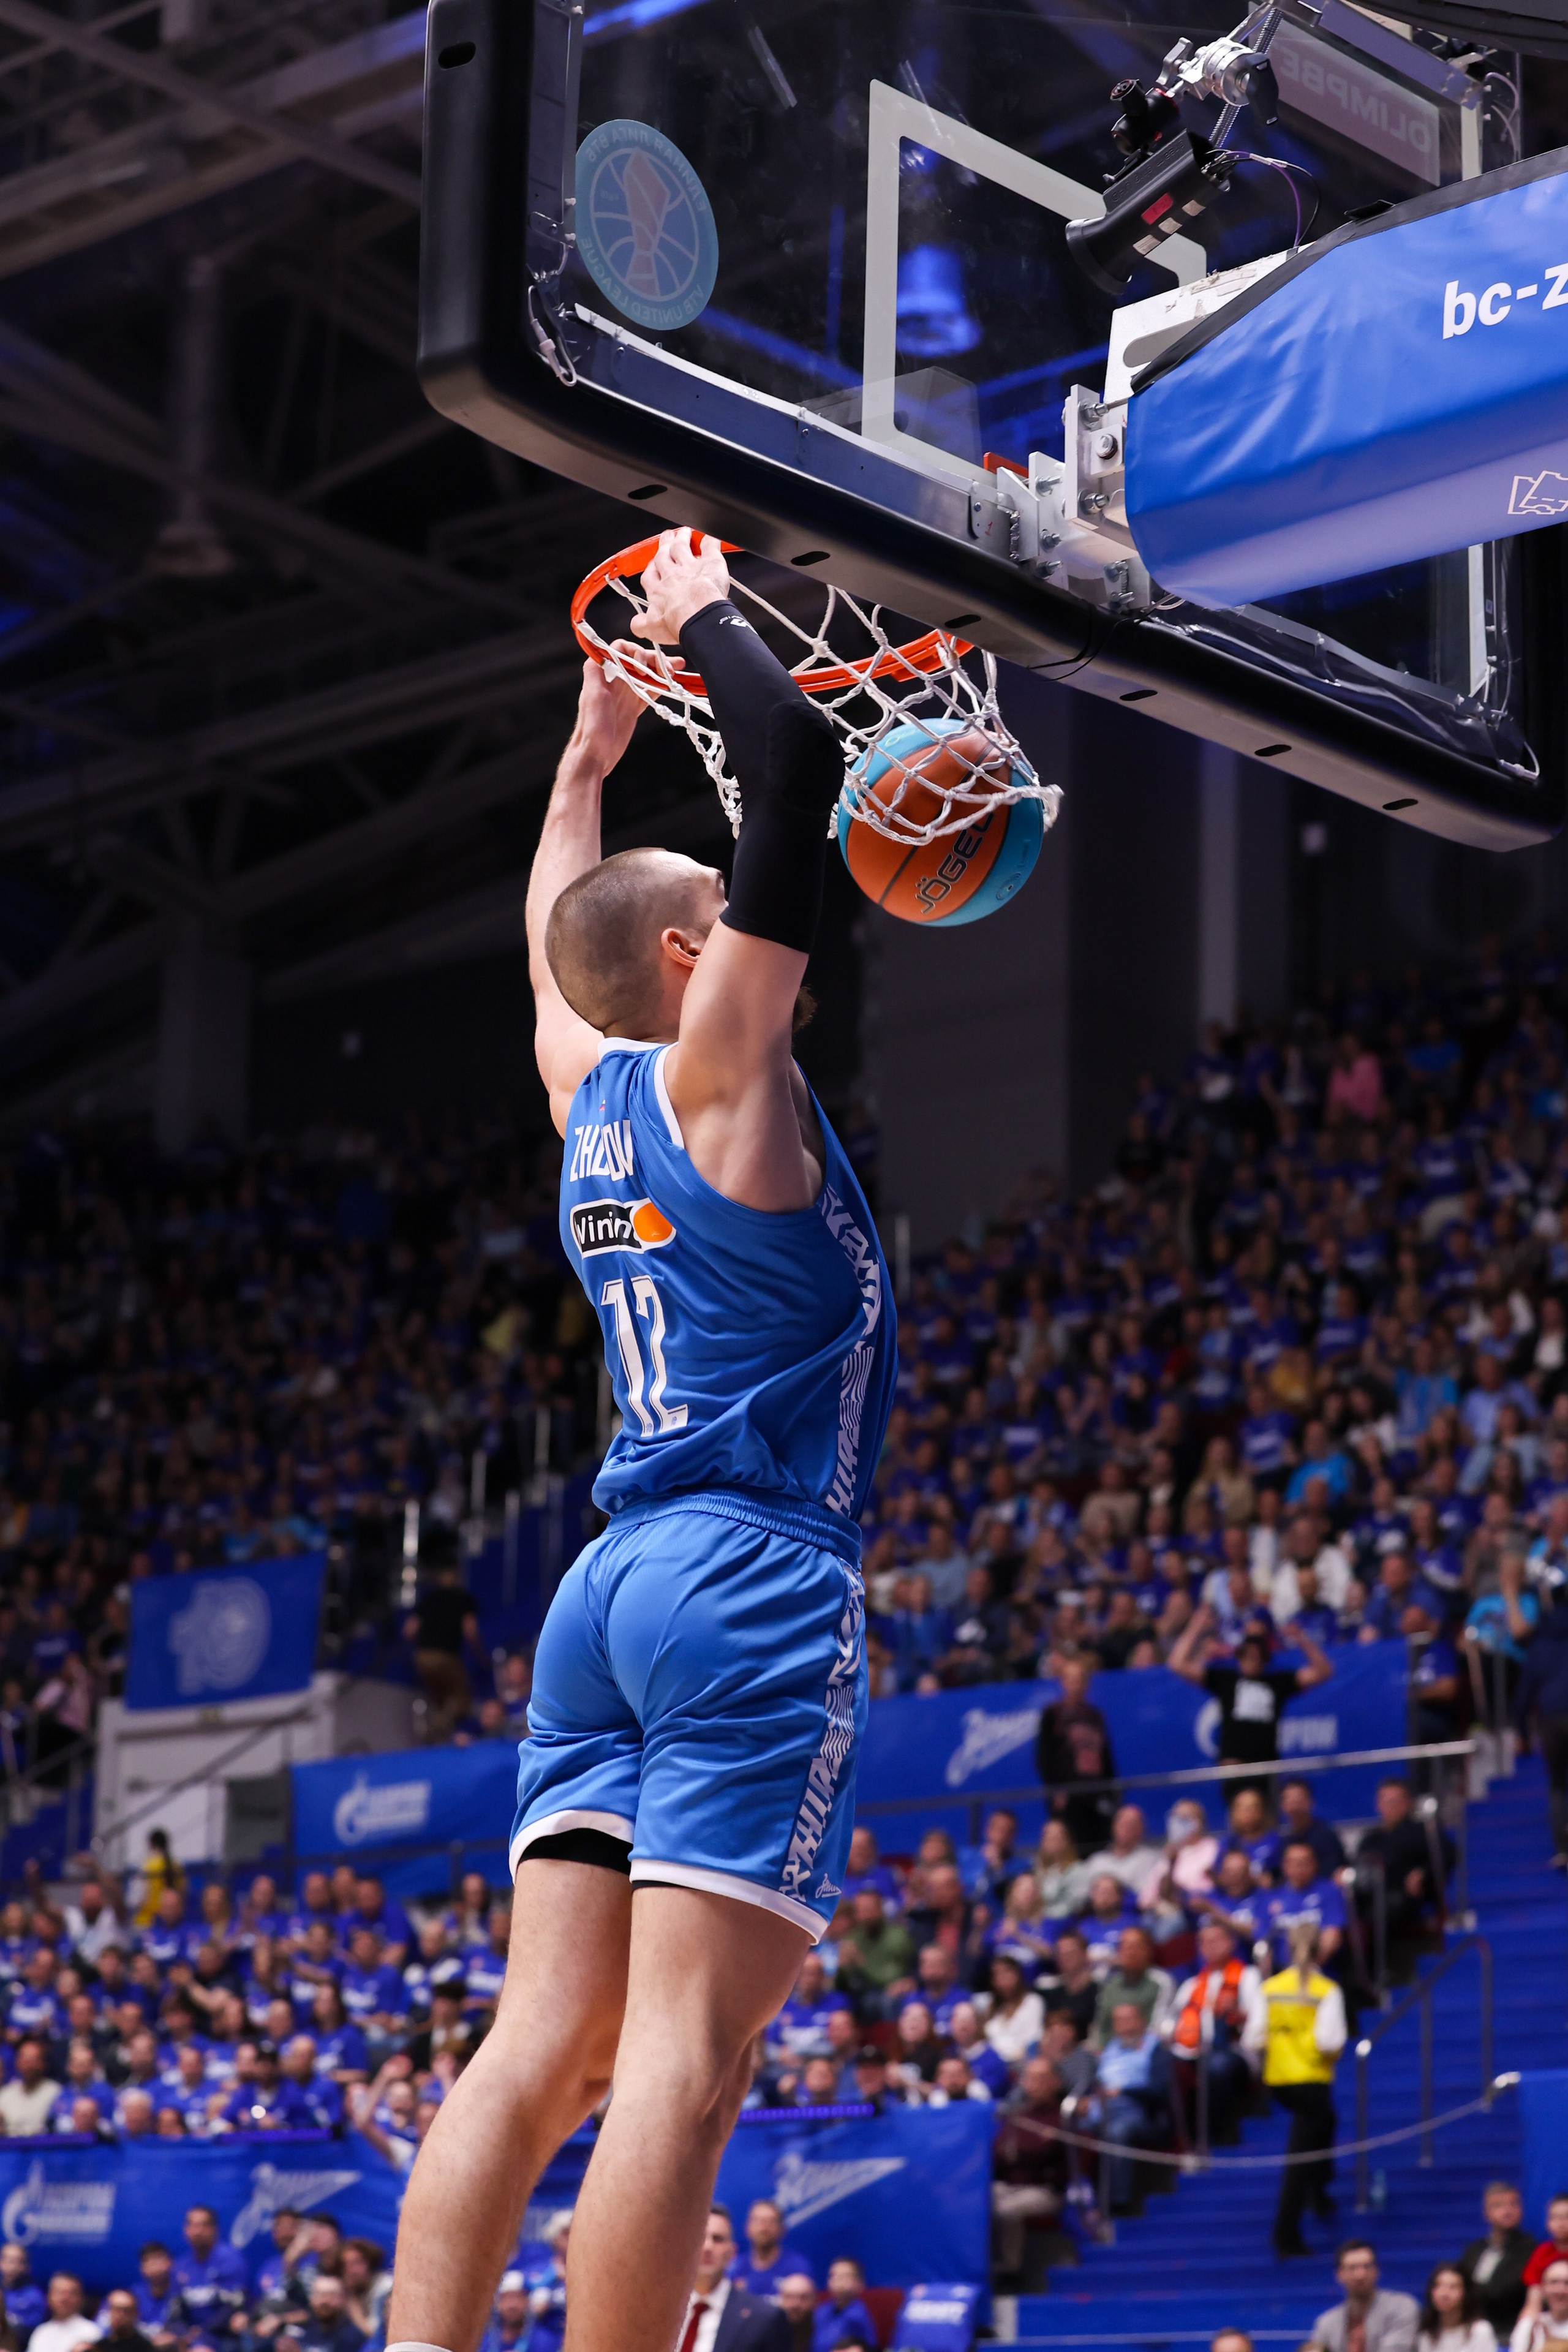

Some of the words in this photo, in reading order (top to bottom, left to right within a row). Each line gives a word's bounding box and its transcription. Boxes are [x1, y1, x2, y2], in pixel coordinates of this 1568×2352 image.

[1442, 262, 1568, 340] bc-z
[915, 812, 995, 915] JÖGEL
[600, 1274, 688, 1438] 12
